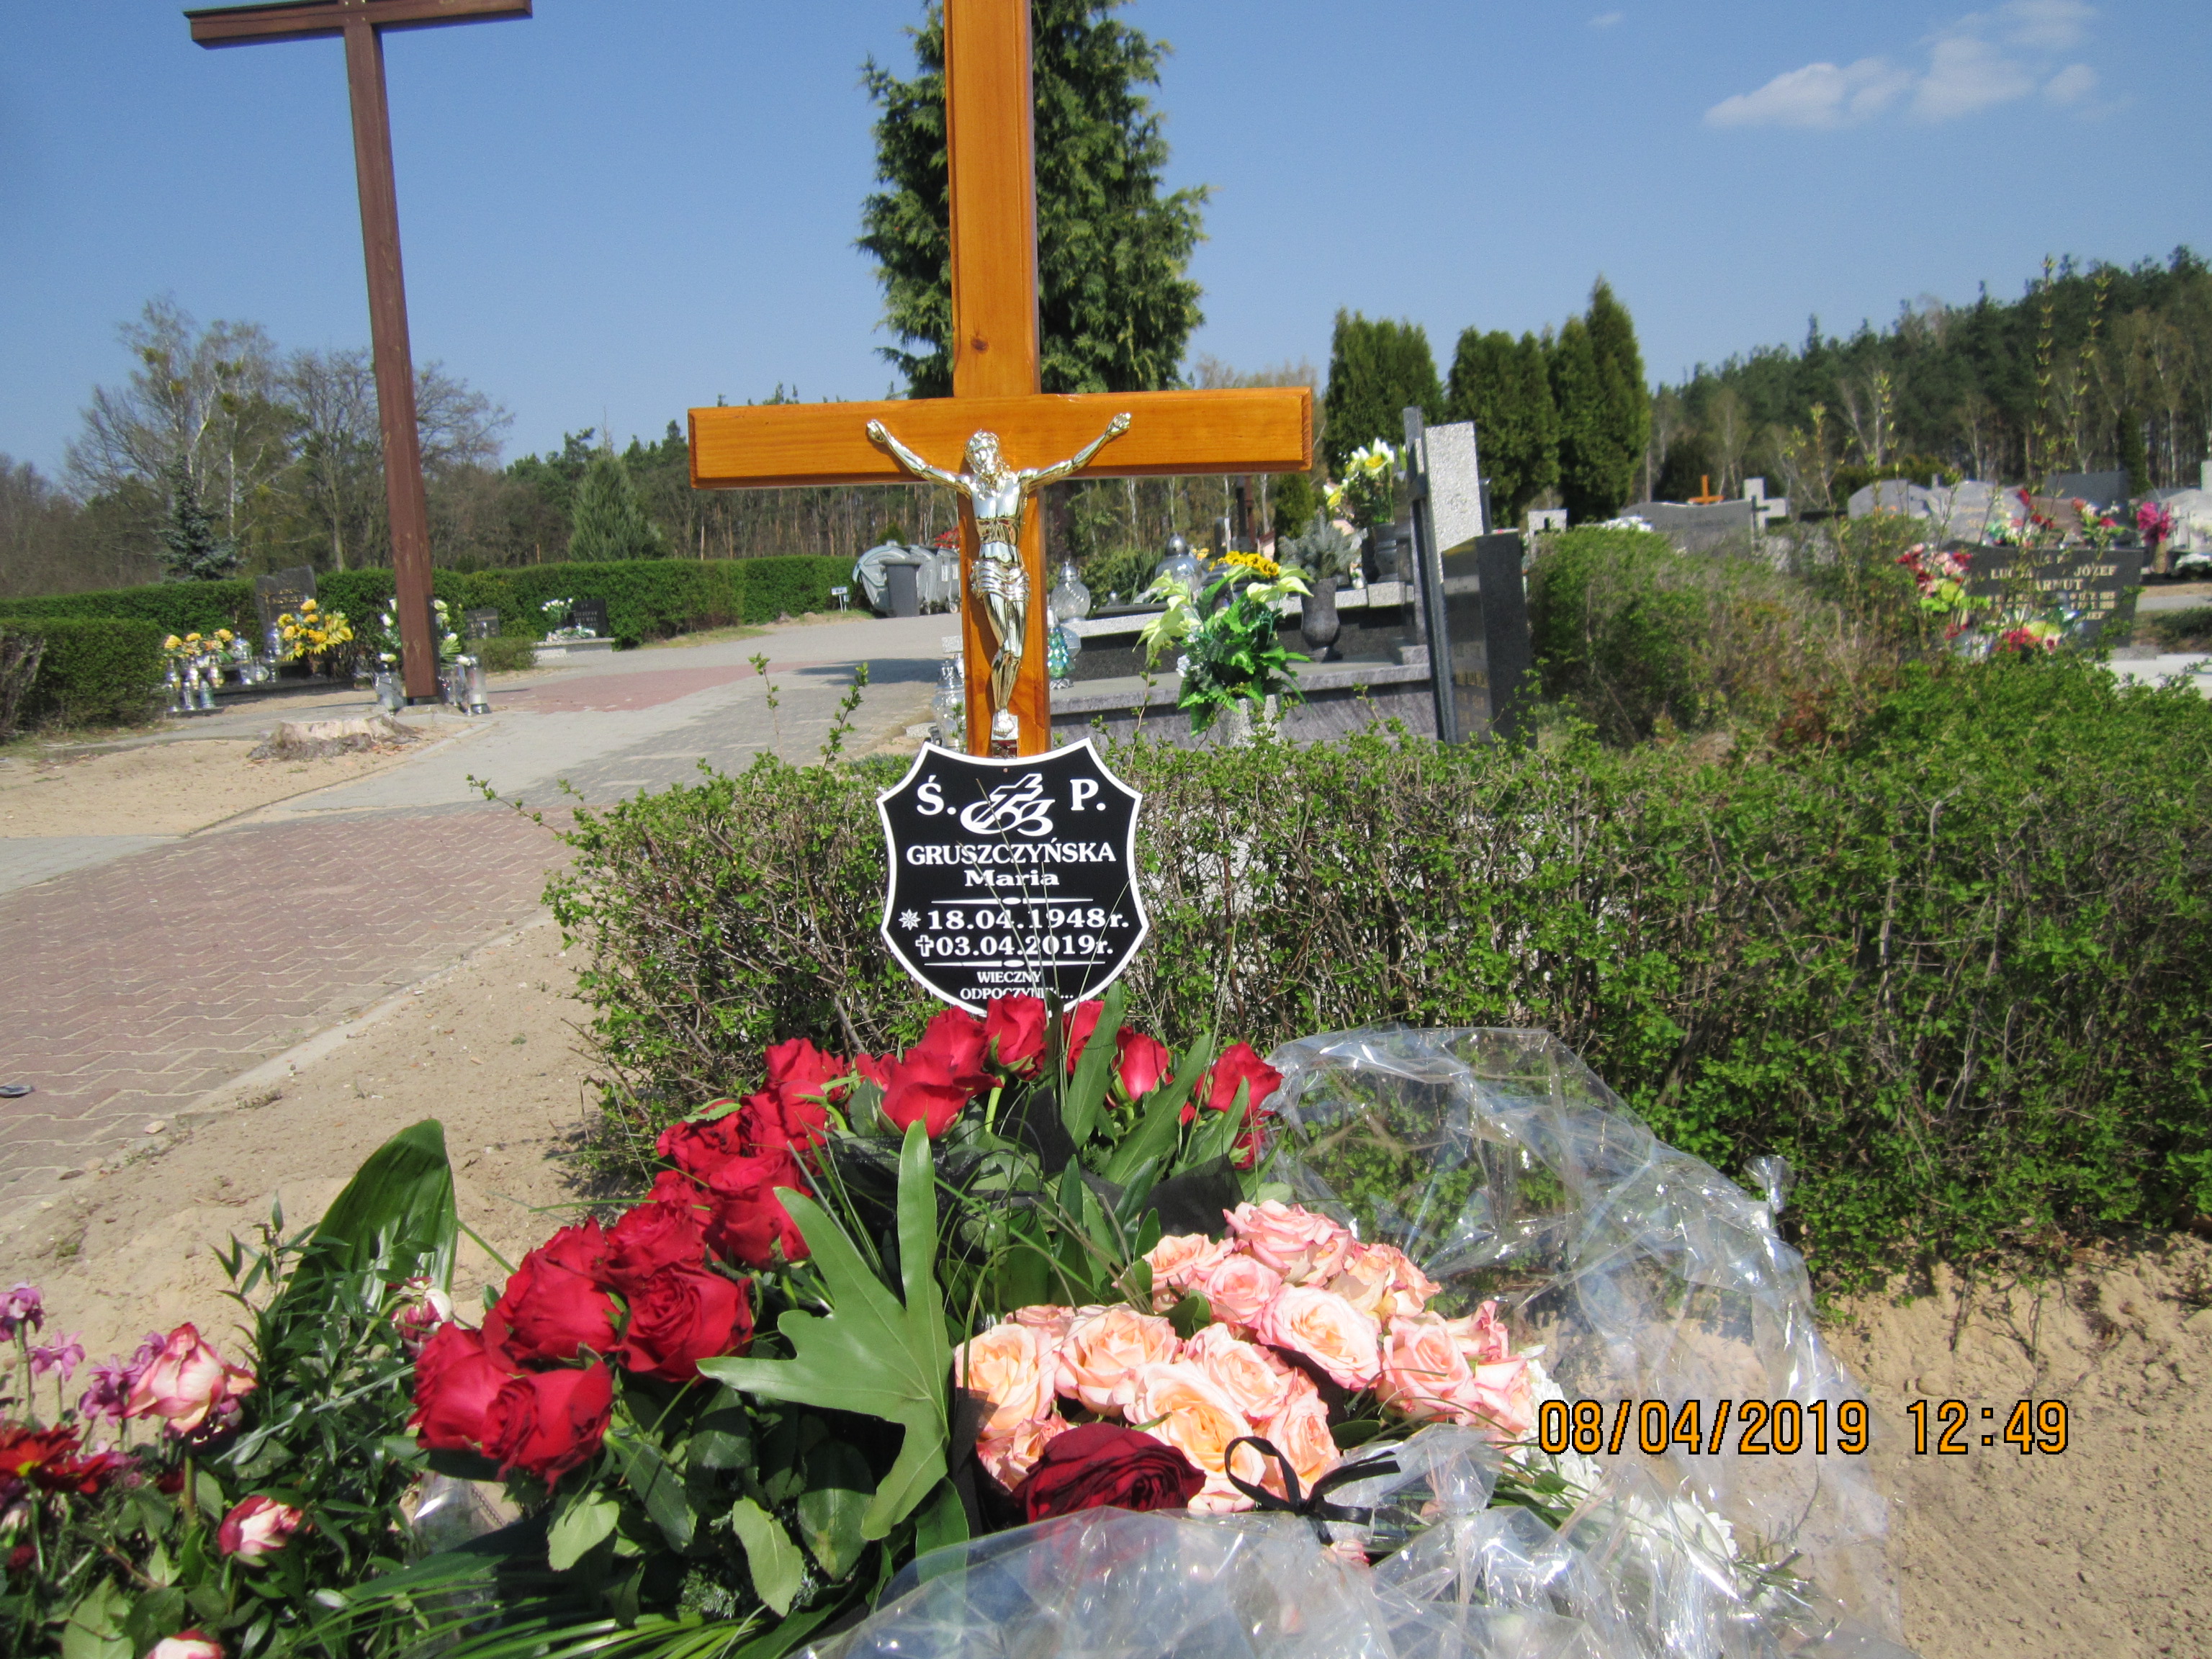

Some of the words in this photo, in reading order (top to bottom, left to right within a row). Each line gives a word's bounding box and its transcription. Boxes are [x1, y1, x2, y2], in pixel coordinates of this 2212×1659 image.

[916, 775, 957, 816] Ś.
[1069, 778, 1107, 811] P.
[906, 837, 1117, 865] GRUSZCZYŃSKA
[963, 869, 1060, 887] Maria
[976, 971, 1042, 984] WIECZNY
